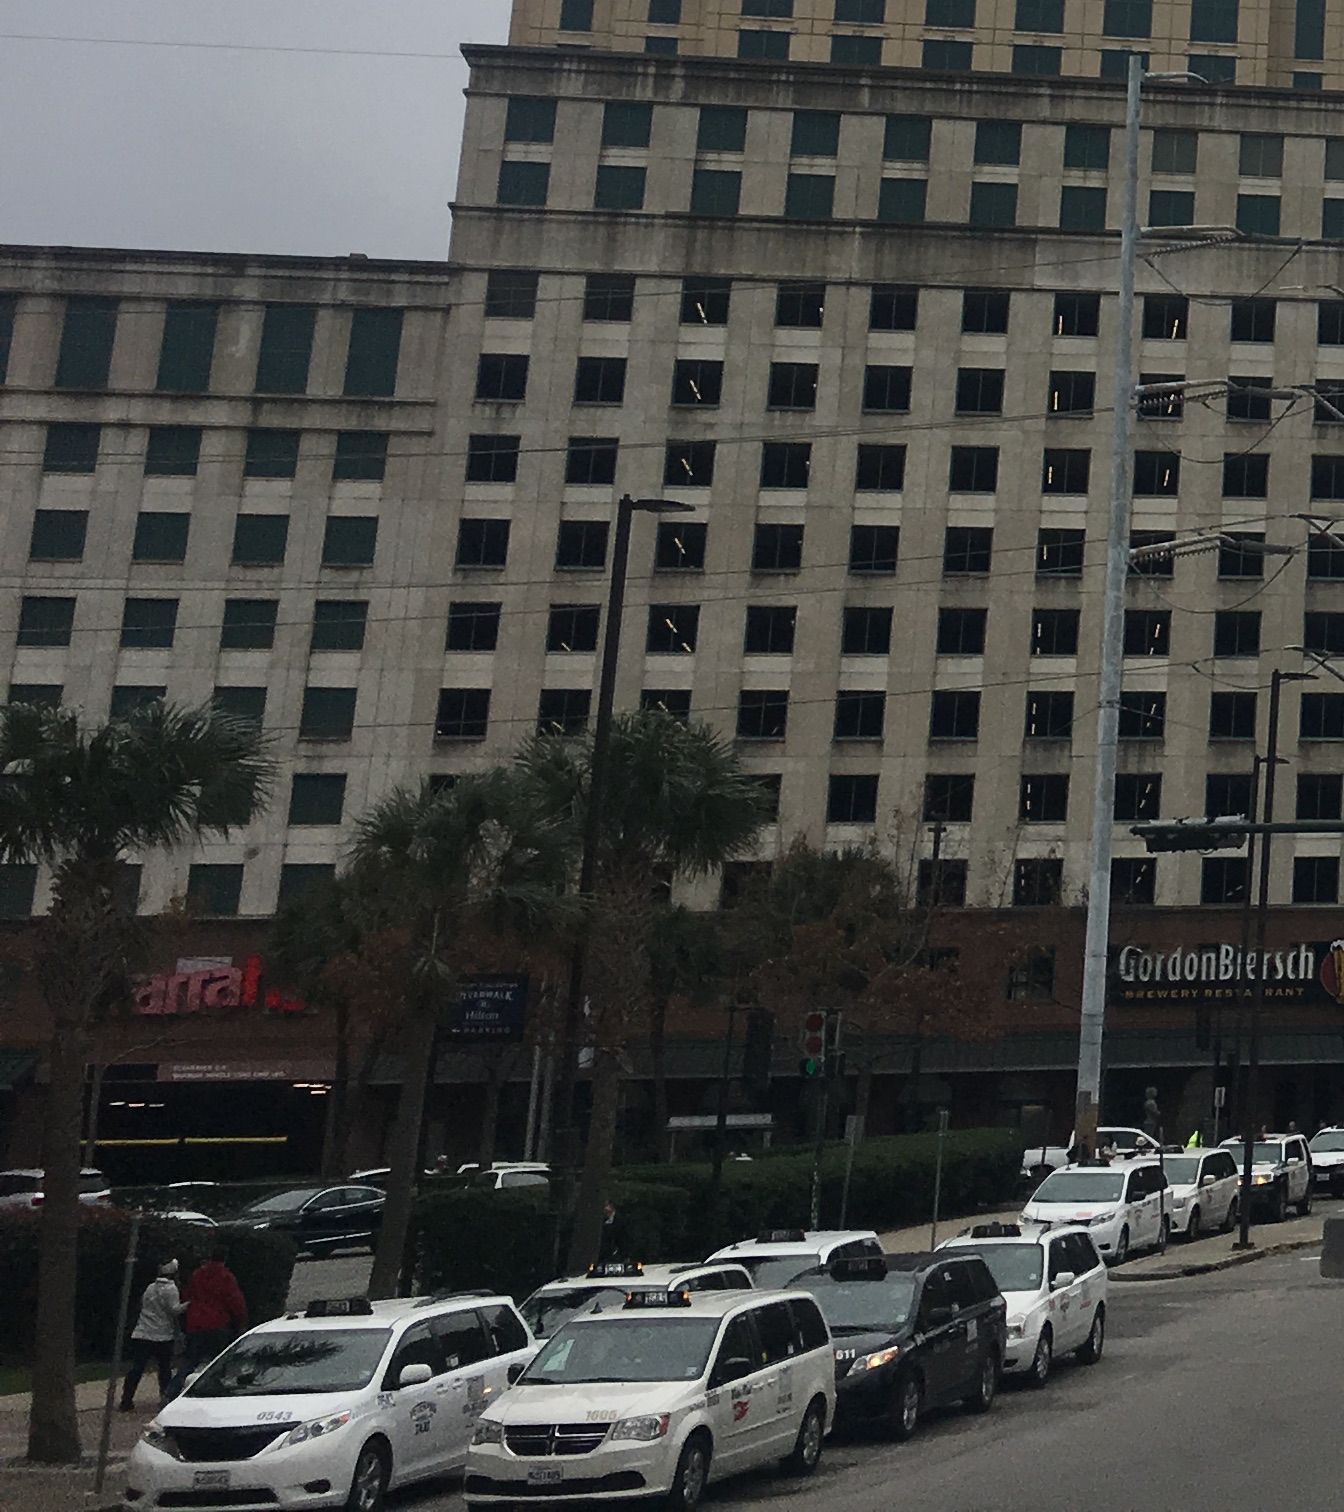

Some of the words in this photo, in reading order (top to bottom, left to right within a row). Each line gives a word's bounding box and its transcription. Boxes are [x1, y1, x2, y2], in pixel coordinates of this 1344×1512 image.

[1124, 989, 1198, 999] BREWERY
[1204, 987, 1305, 998] RESARANT
[256, 1411, 293, 1421] 0543
